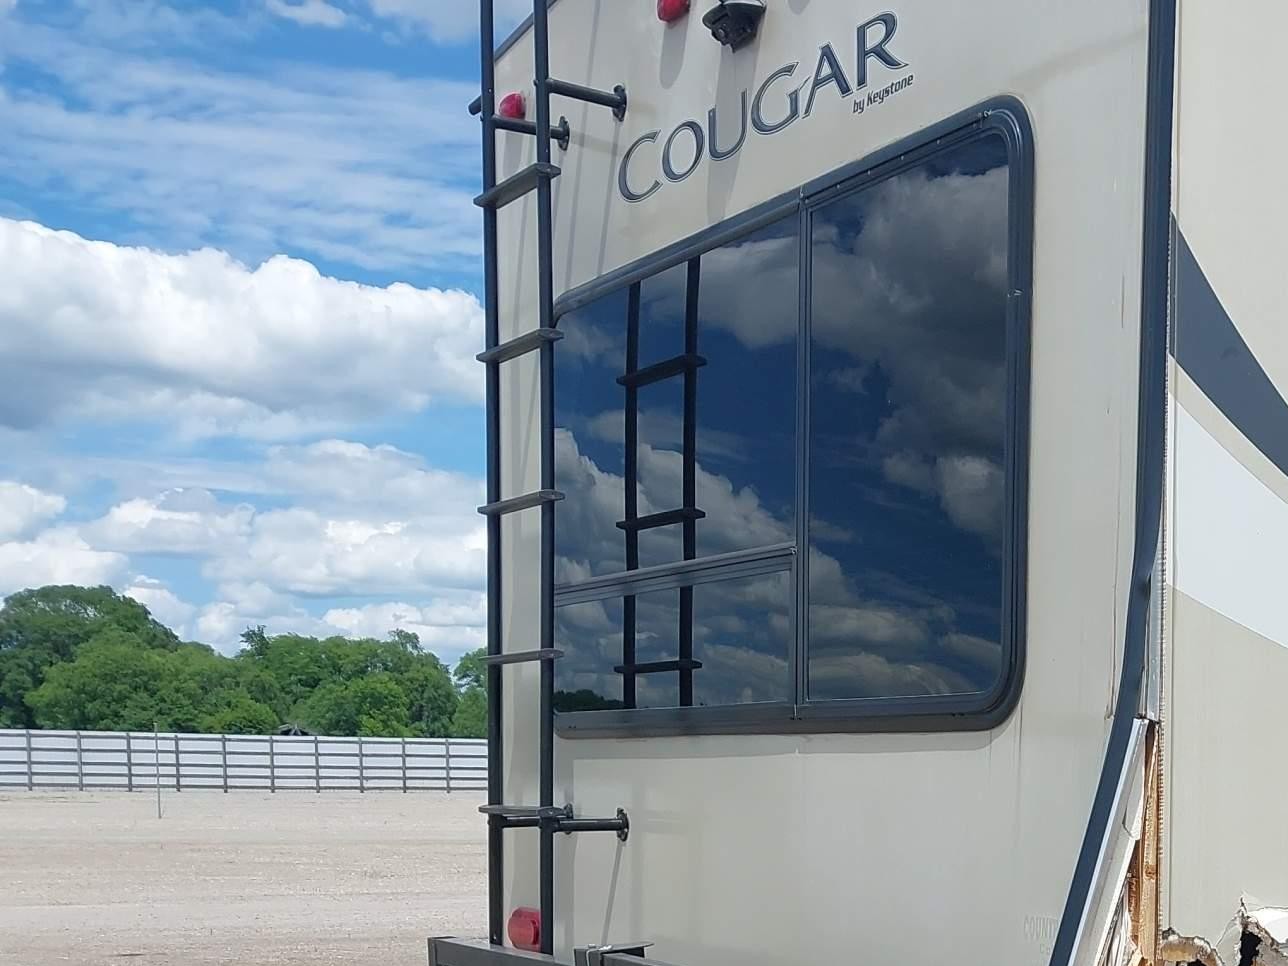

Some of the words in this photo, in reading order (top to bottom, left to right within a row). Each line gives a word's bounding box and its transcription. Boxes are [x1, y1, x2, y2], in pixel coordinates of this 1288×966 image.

[618, 11, 909, 203] COUGAR
[852, 99, 865, 114] by
[866, 74, 914, 105] Keystone
